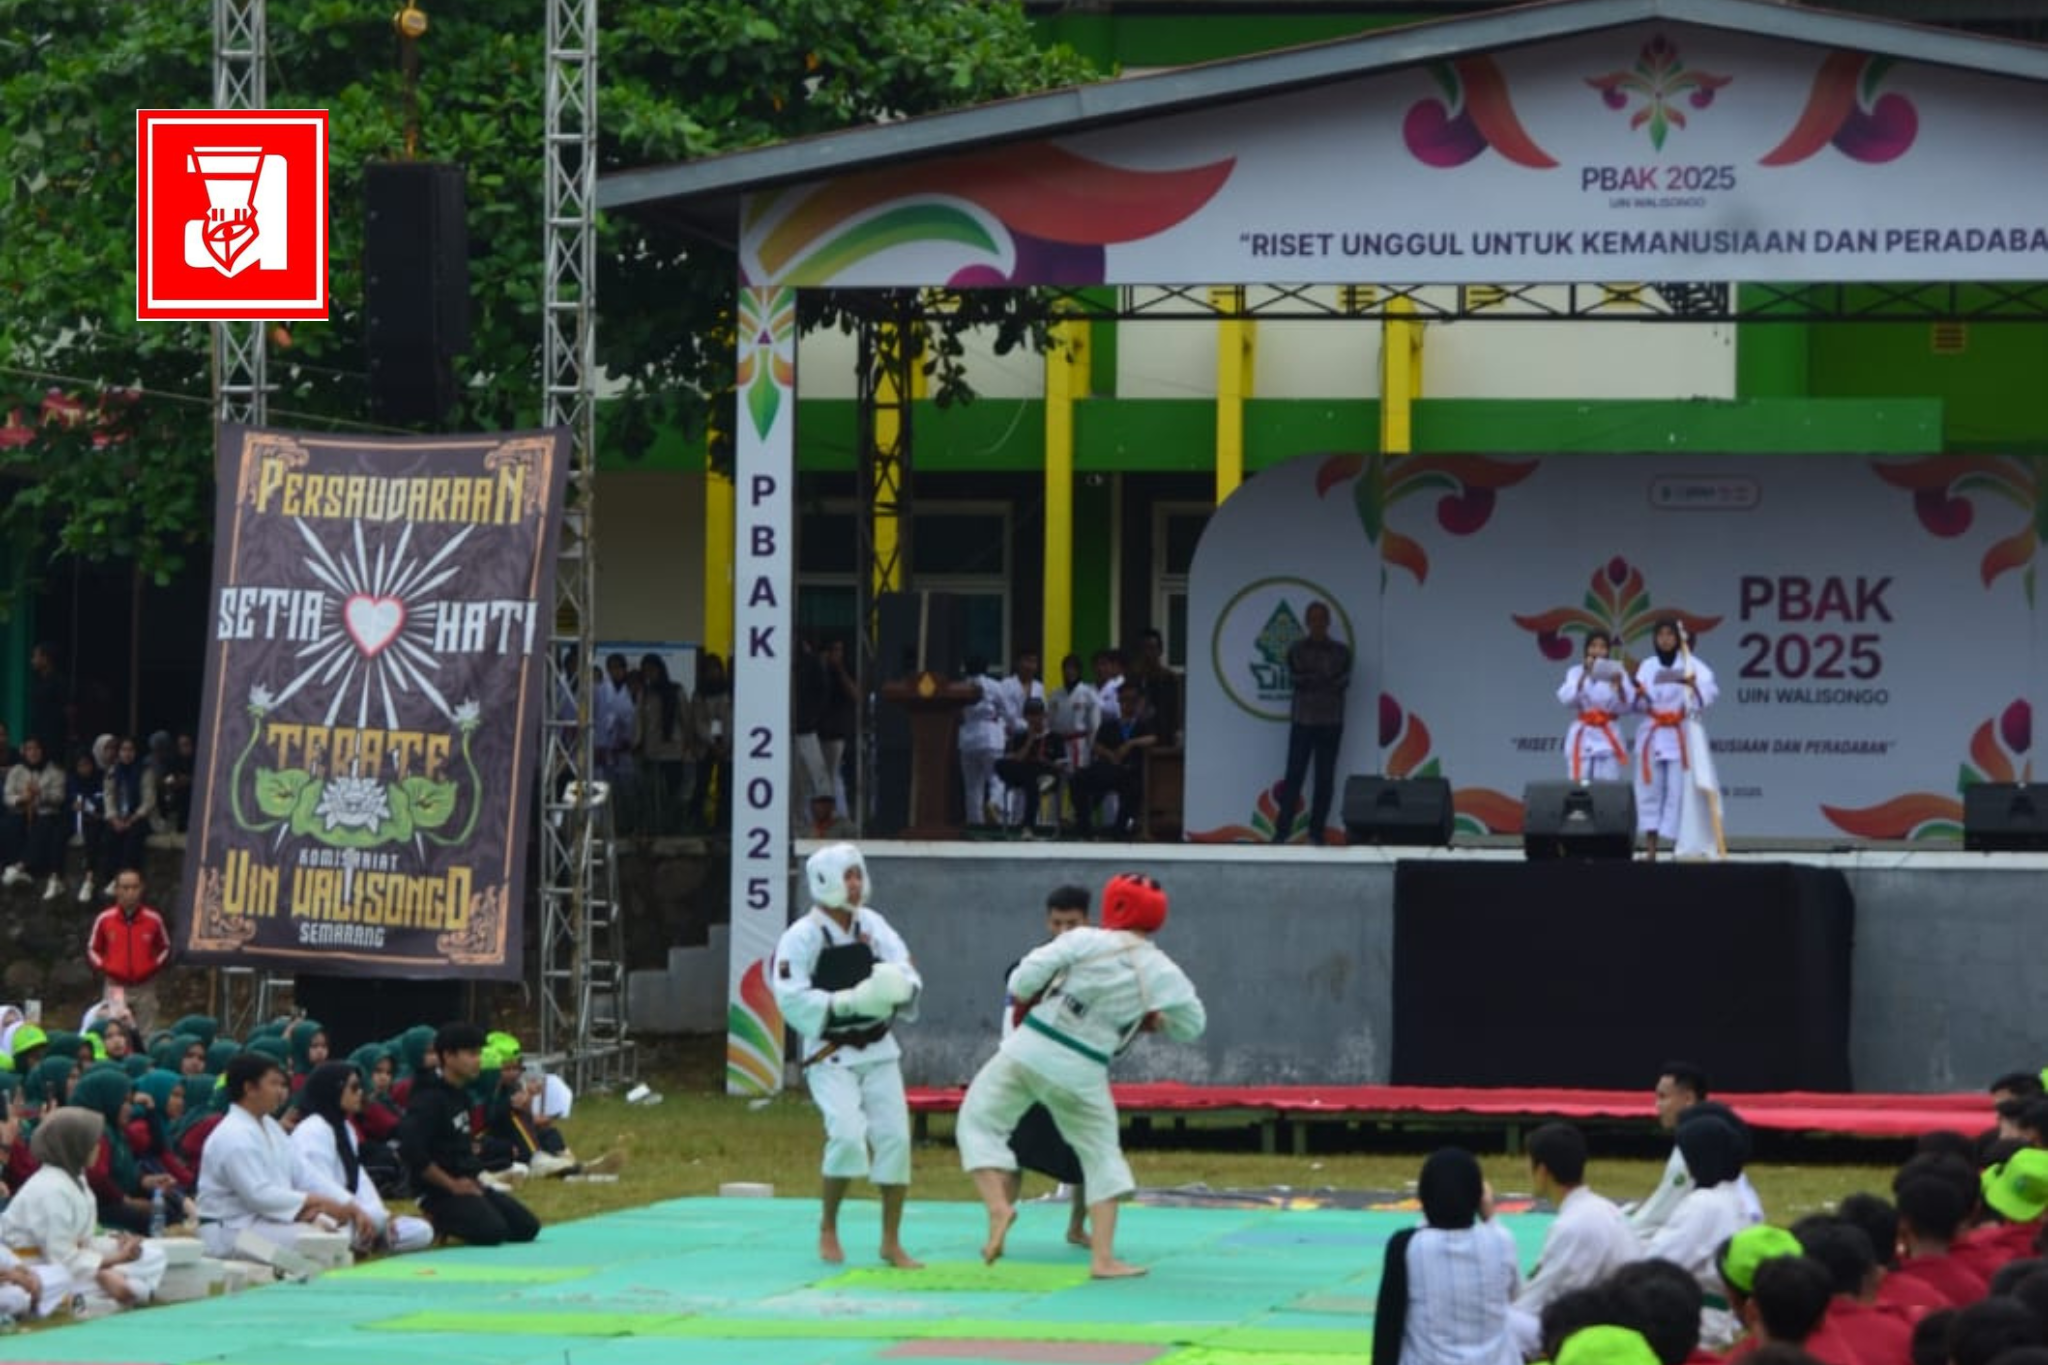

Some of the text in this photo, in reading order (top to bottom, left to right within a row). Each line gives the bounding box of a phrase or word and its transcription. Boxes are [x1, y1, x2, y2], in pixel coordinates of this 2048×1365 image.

[1581, 165, 1737, 191] PBAK 2025
[1341, 231, 1464, 257] UNGGUL
[1472, 231, 1574, 256] UNTUK
[1582, 230, 1806, 255] KEMANUSIAAN
[1814, 229, 1878, 254] DAN
[1885, 228, 2048, 254] PERADABA
[256, 457, 527, 525] PERSAUDARAAN
[217, 587, 538, 655] SETIA HATI
[1739, 576, 1894, 623] PBAK
[1738, 633, 1882, 680] 2025
[746, 475, 777, 910] PBAK 2025
[1737, 688, 1889, 705] UIN WALISONGO
[266, 723, 450, 781] TERATE
[1772, 739, 1802, 754] DAN
[291, 866, 472, 931] WALISONGO
[299, 921, 386, 948] SEMARANG
